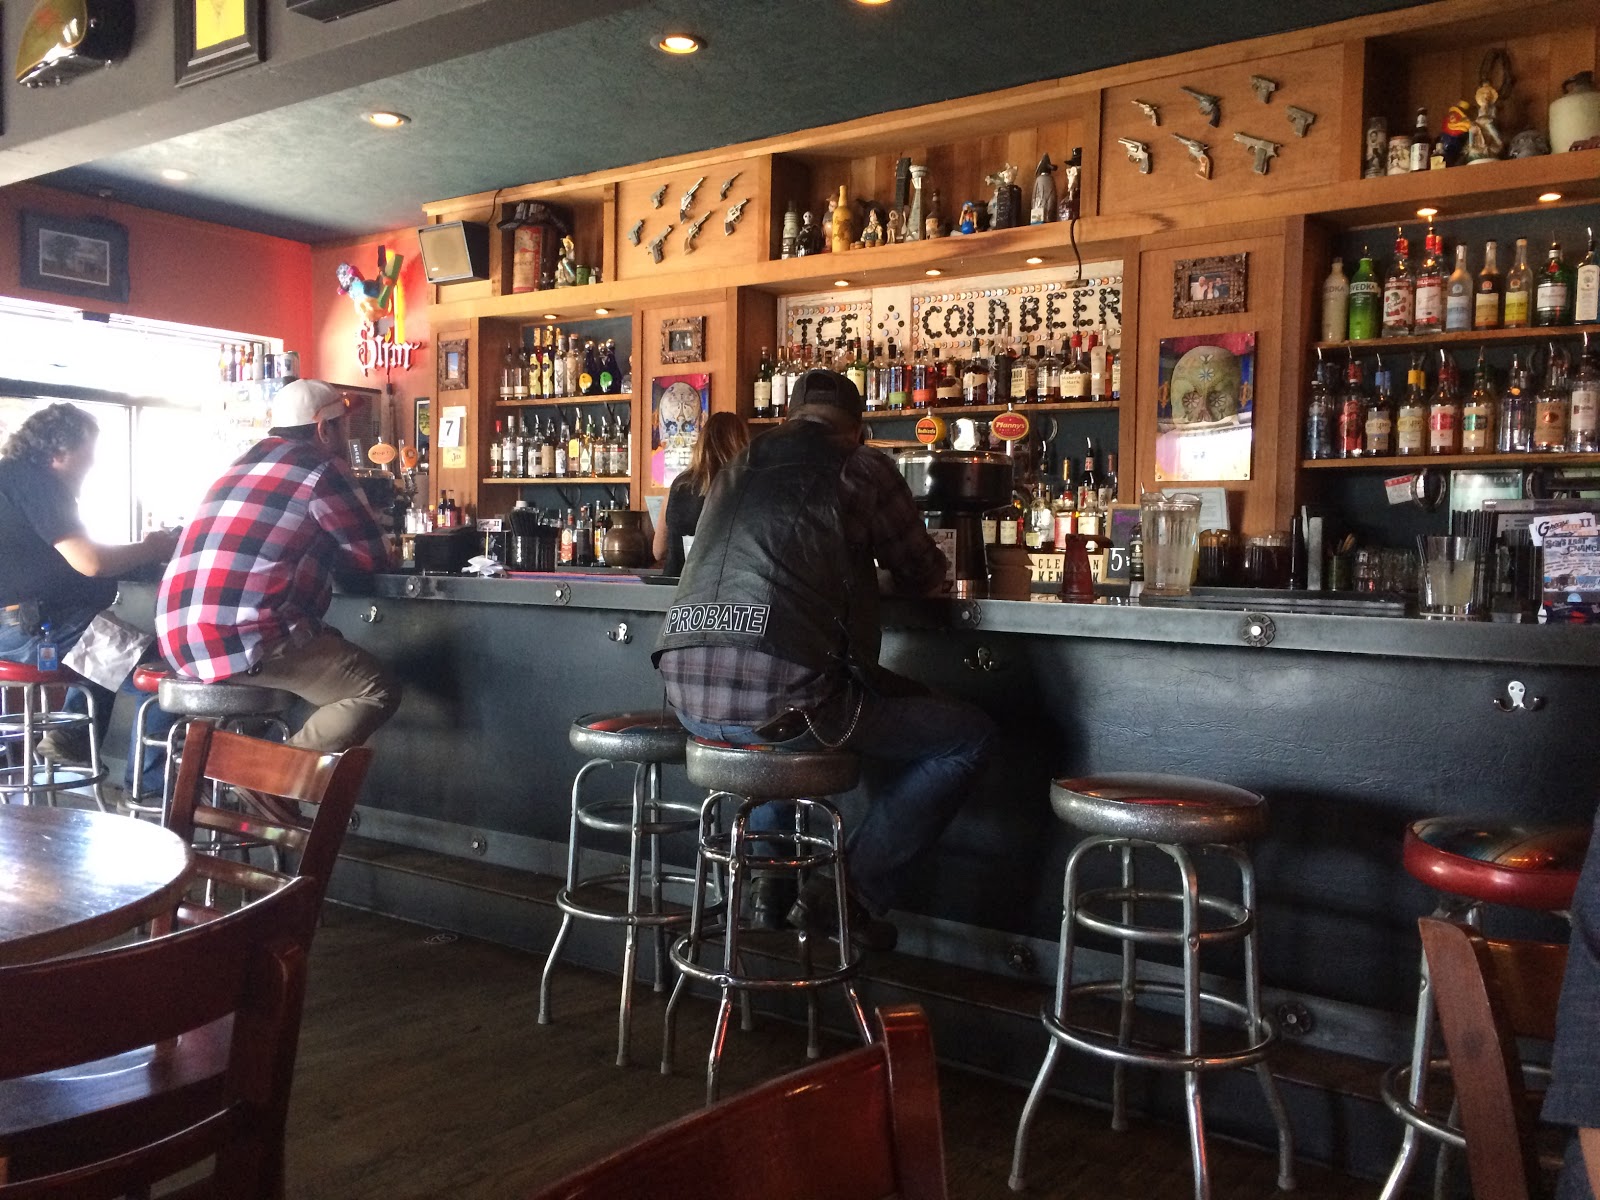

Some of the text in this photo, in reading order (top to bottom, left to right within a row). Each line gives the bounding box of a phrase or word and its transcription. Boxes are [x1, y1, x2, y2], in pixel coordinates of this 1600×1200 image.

[922, 299, 1010, 339] COLD
[1020, 287, 1121, 332] BEER
[446, 420, 454, 436] 7
[1110, 547, 1126, 571] 5
[665, 604, 766, 634] PROBATE
